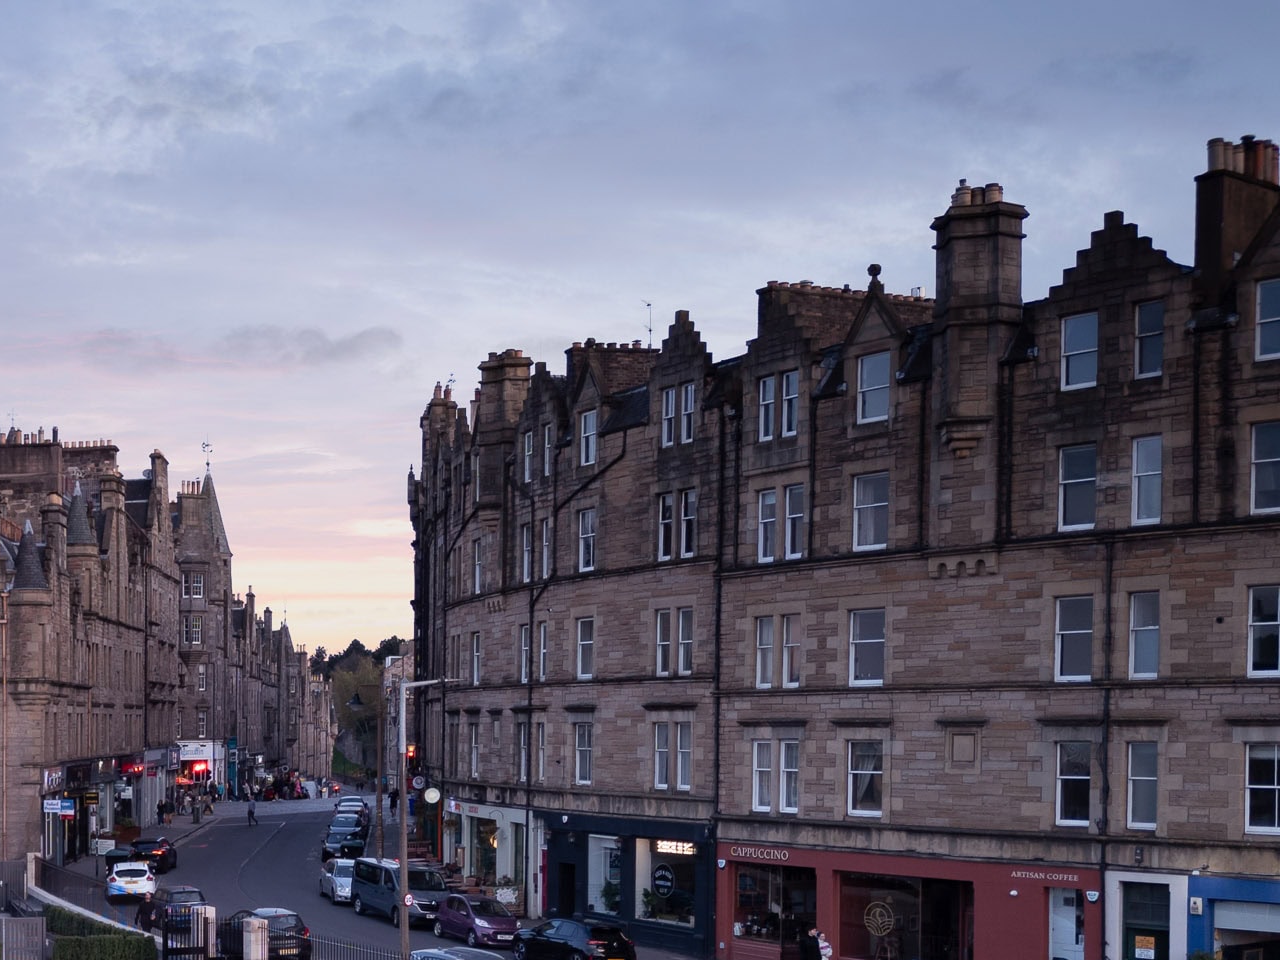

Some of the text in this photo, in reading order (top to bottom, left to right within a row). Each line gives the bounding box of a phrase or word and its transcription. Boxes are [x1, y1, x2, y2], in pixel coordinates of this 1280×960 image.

[730, 846, 789, 861] CAPPUCCINO
[1011, 871, 1079, 882] ARTISAN COFFEE
